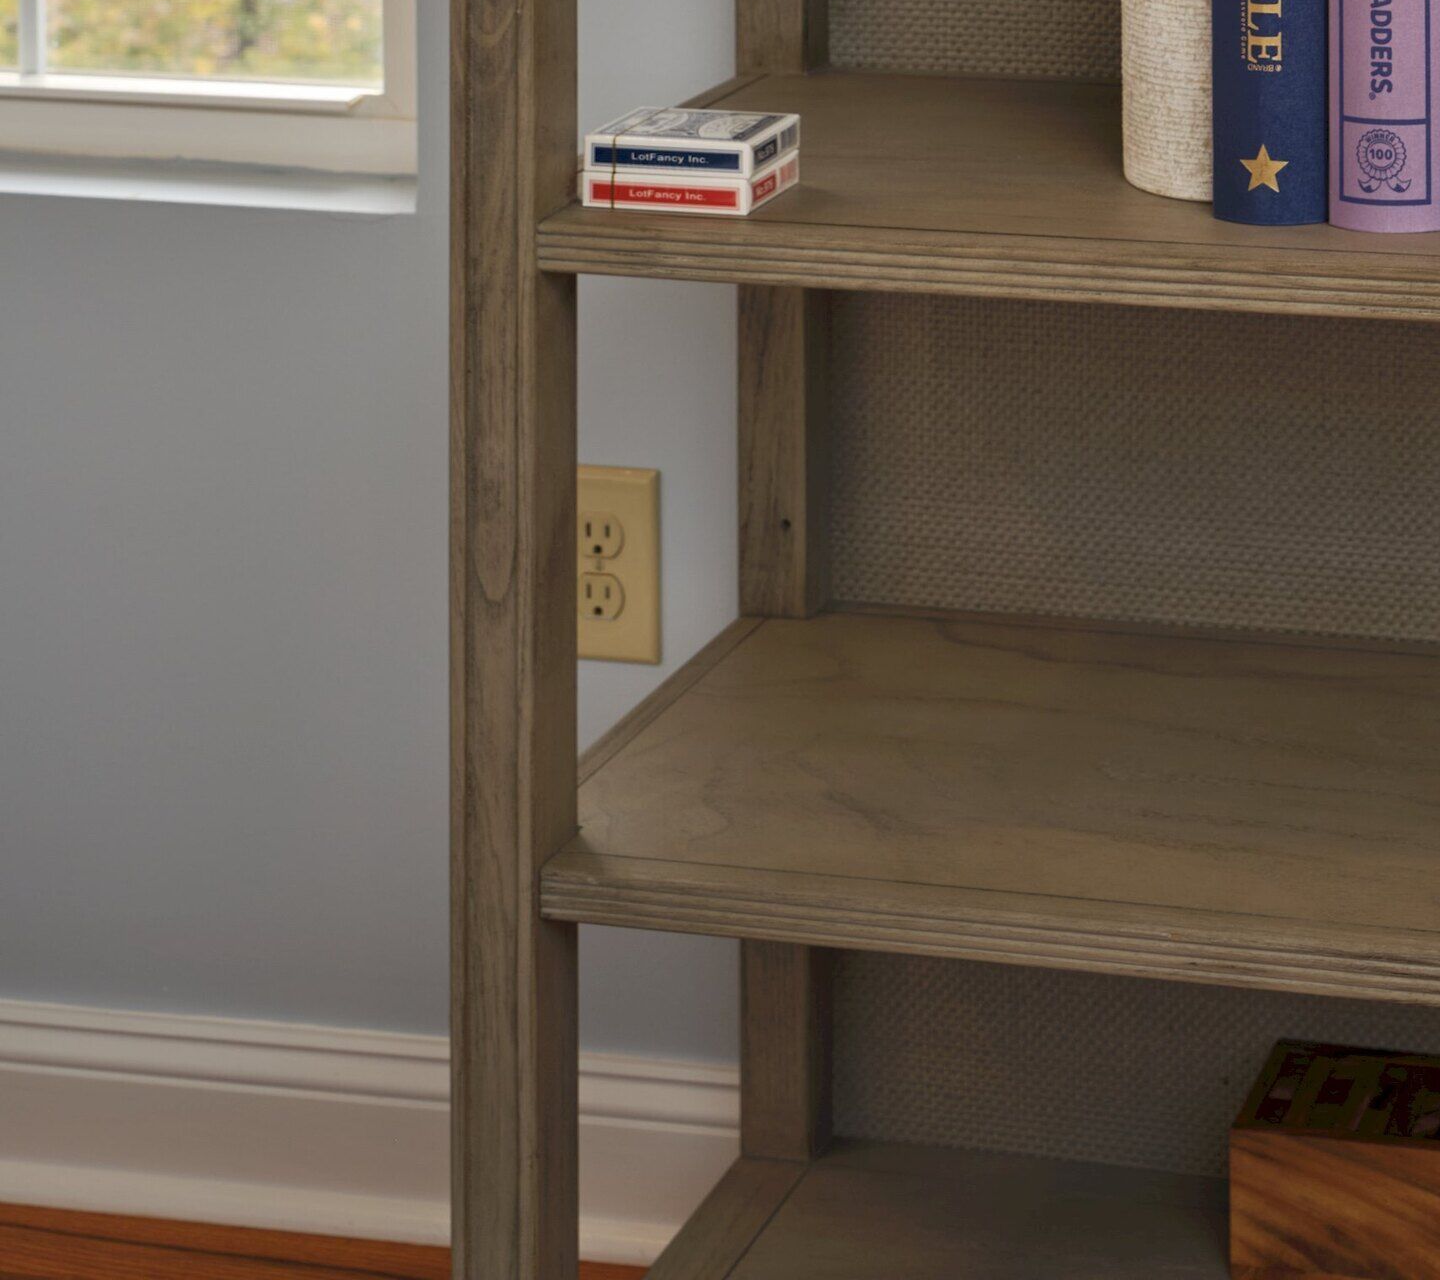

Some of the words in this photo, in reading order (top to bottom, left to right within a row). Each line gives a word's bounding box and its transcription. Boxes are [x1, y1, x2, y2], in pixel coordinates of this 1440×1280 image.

[631, 153, 684, 164] LotFancy
[688, 155, 709, 163] Inc.
[1370, 149, 1392, 159] 100
[629, 190, 681, 200] LotFancy
[685, 192, 706, 200] Inc.
